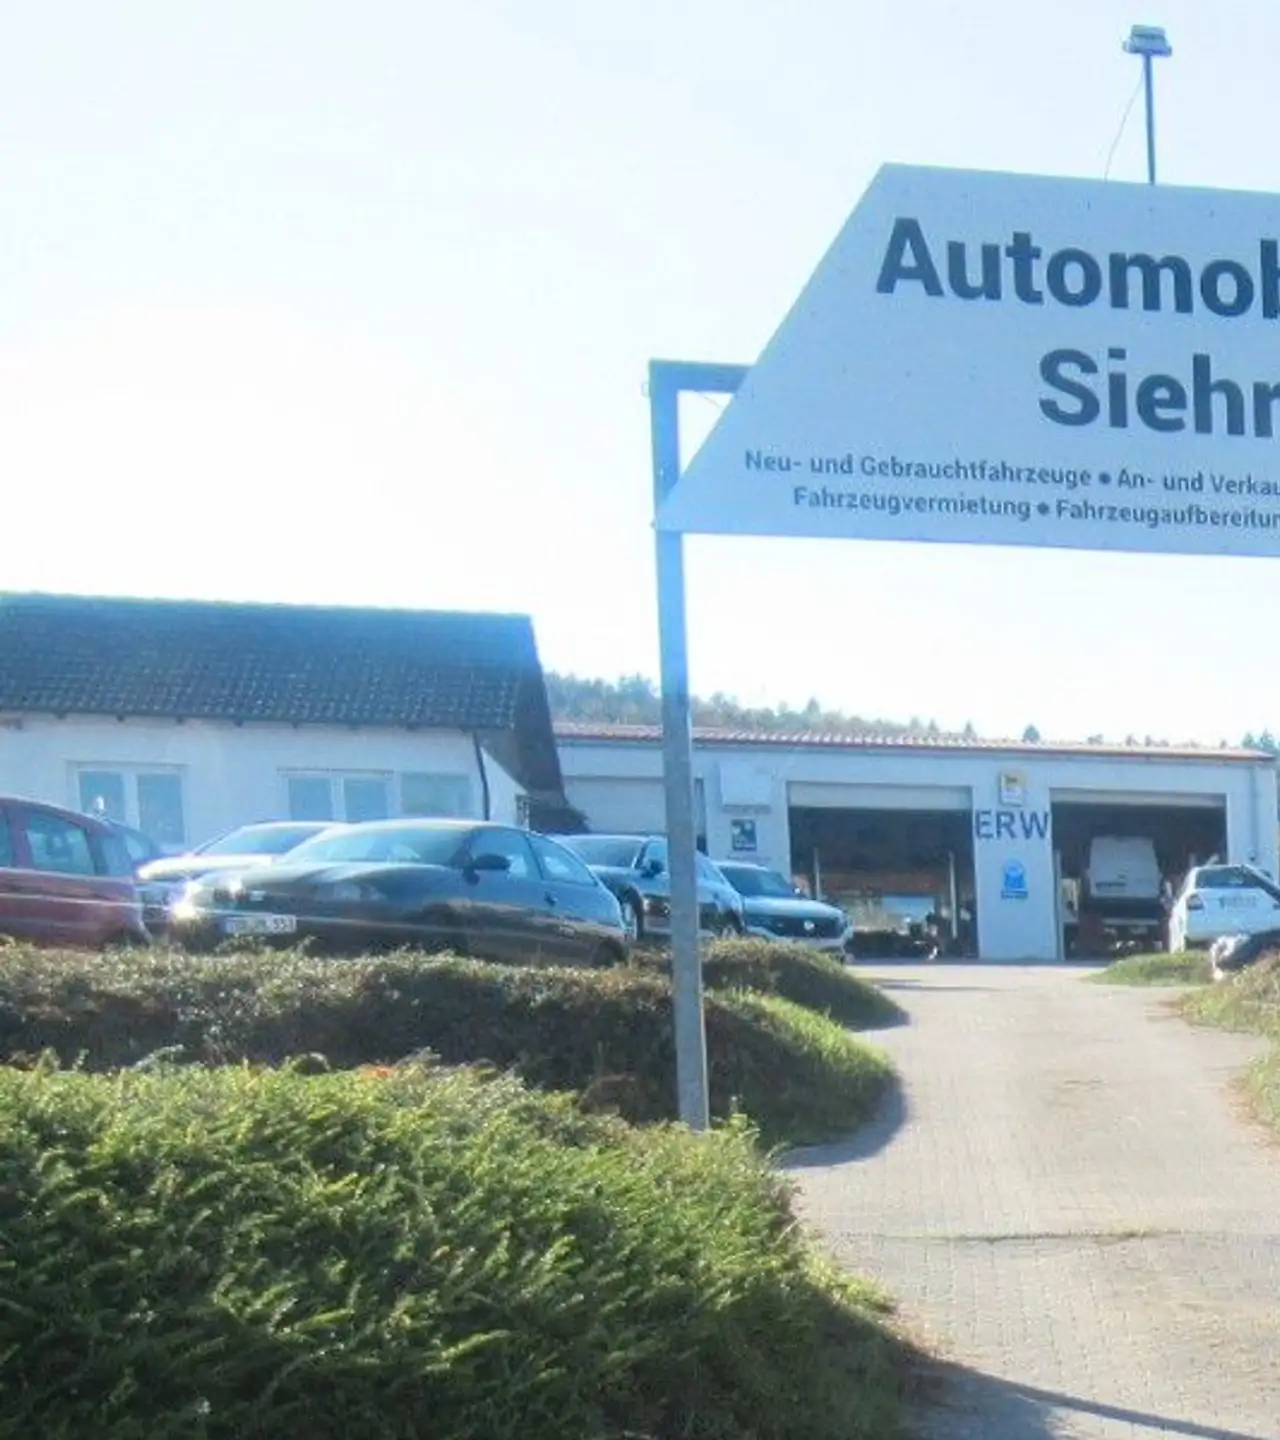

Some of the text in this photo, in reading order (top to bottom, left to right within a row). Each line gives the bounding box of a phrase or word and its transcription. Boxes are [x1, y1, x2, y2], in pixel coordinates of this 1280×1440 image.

[745, 450, 802, 473] Neu-
[811, 453, 853, 475] und
[861, 456, 1092, 489] Gebrauchtfahrzeuge
[1118, 469, 1155, 489] An-
[1163, 471, 1203, 492] und
[793, 486, 1031, 520] Fahrzeugvermietung
[975, 808, 1050, 840] ERW
